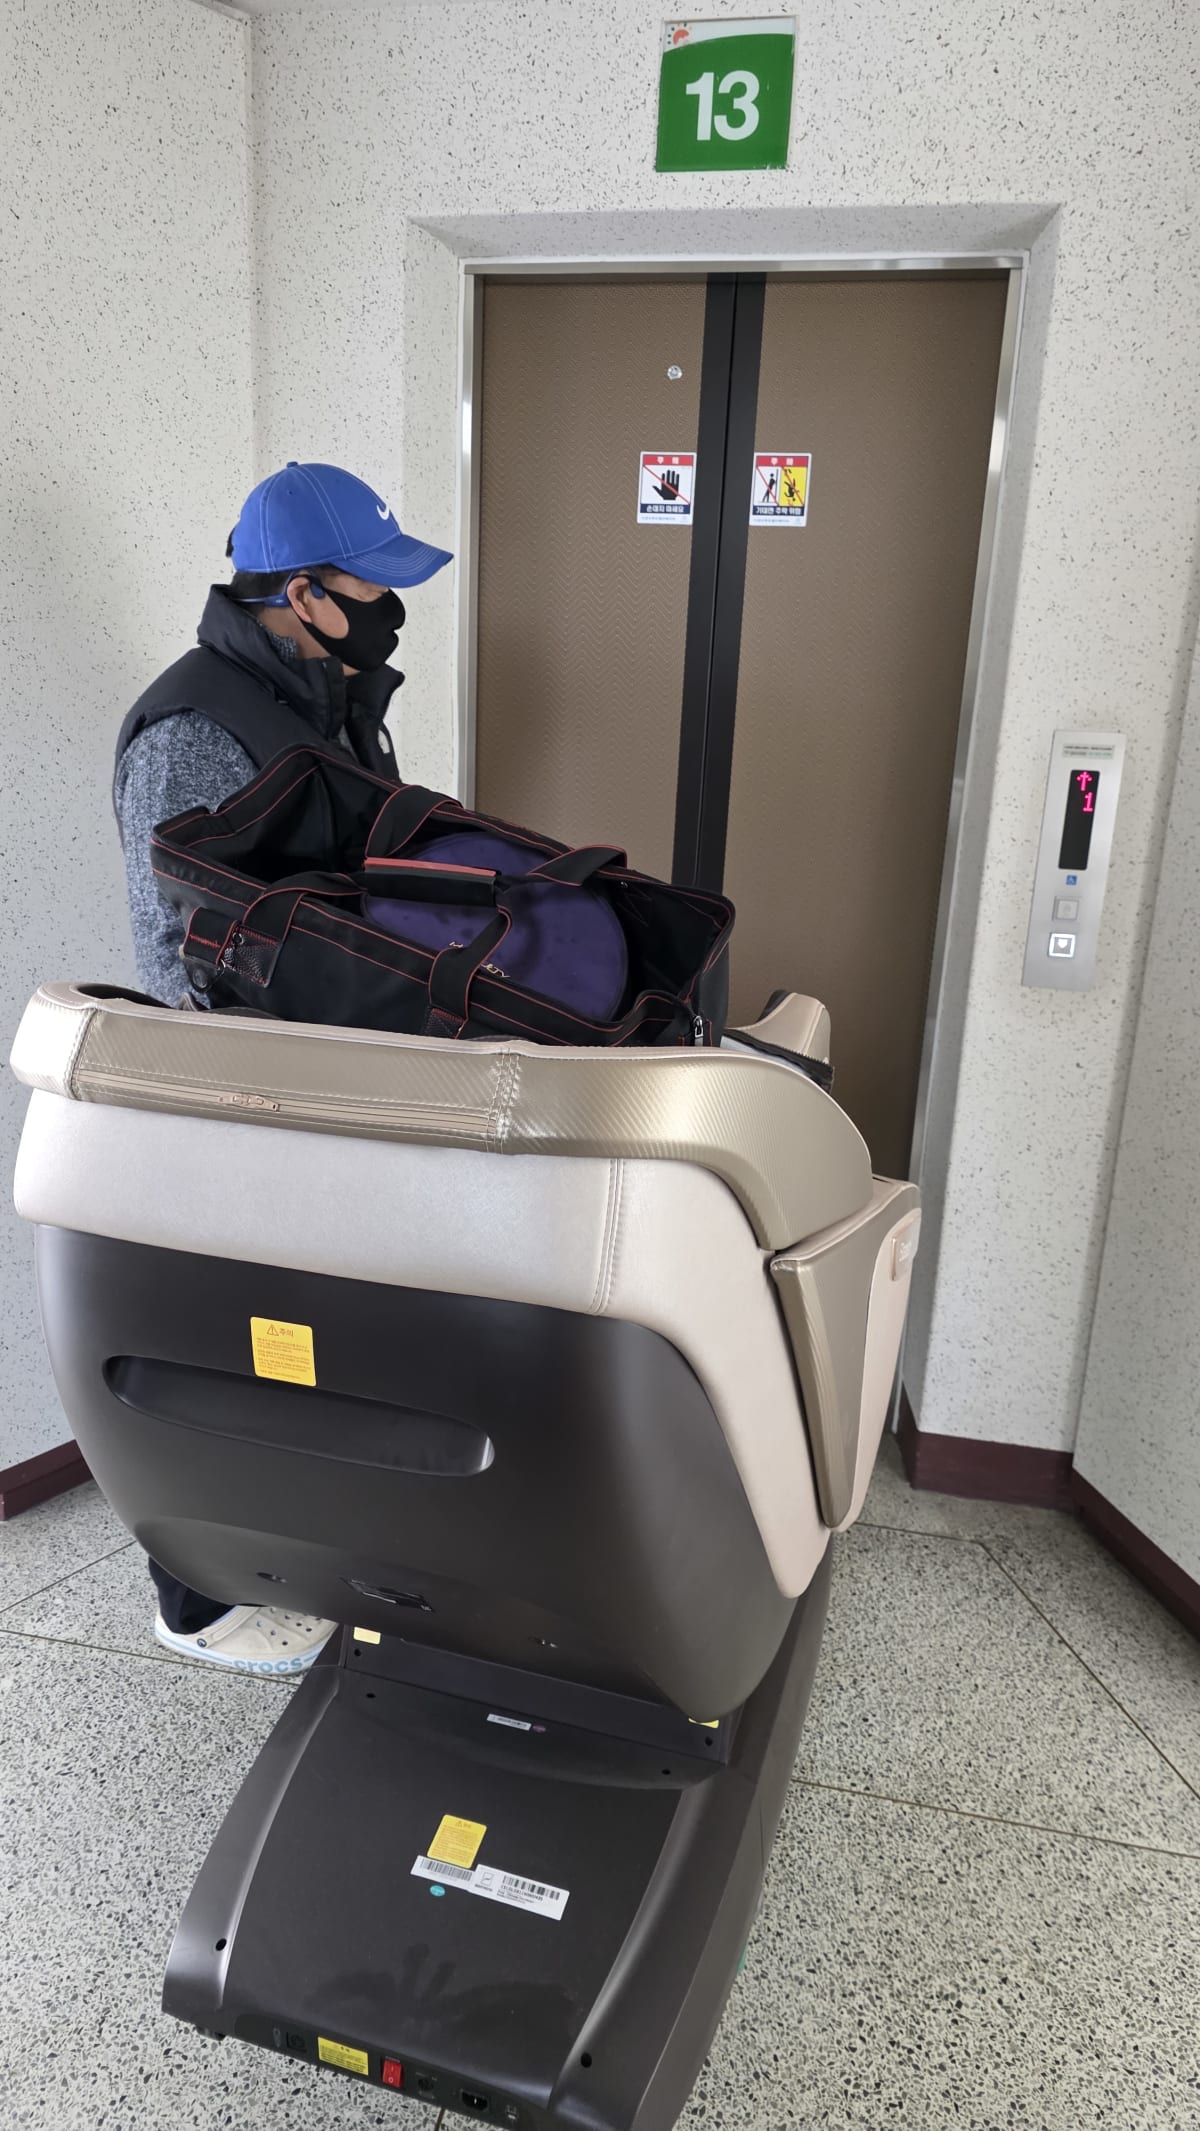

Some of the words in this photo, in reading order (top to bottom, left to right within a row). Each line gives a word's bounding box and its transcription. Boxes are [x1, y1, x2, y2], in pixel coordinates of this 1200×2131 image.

[686, 70, 760, 141] 13
[1083, 792, 1094, 812] 1
[234, 1658, 302, 1673] crocs
